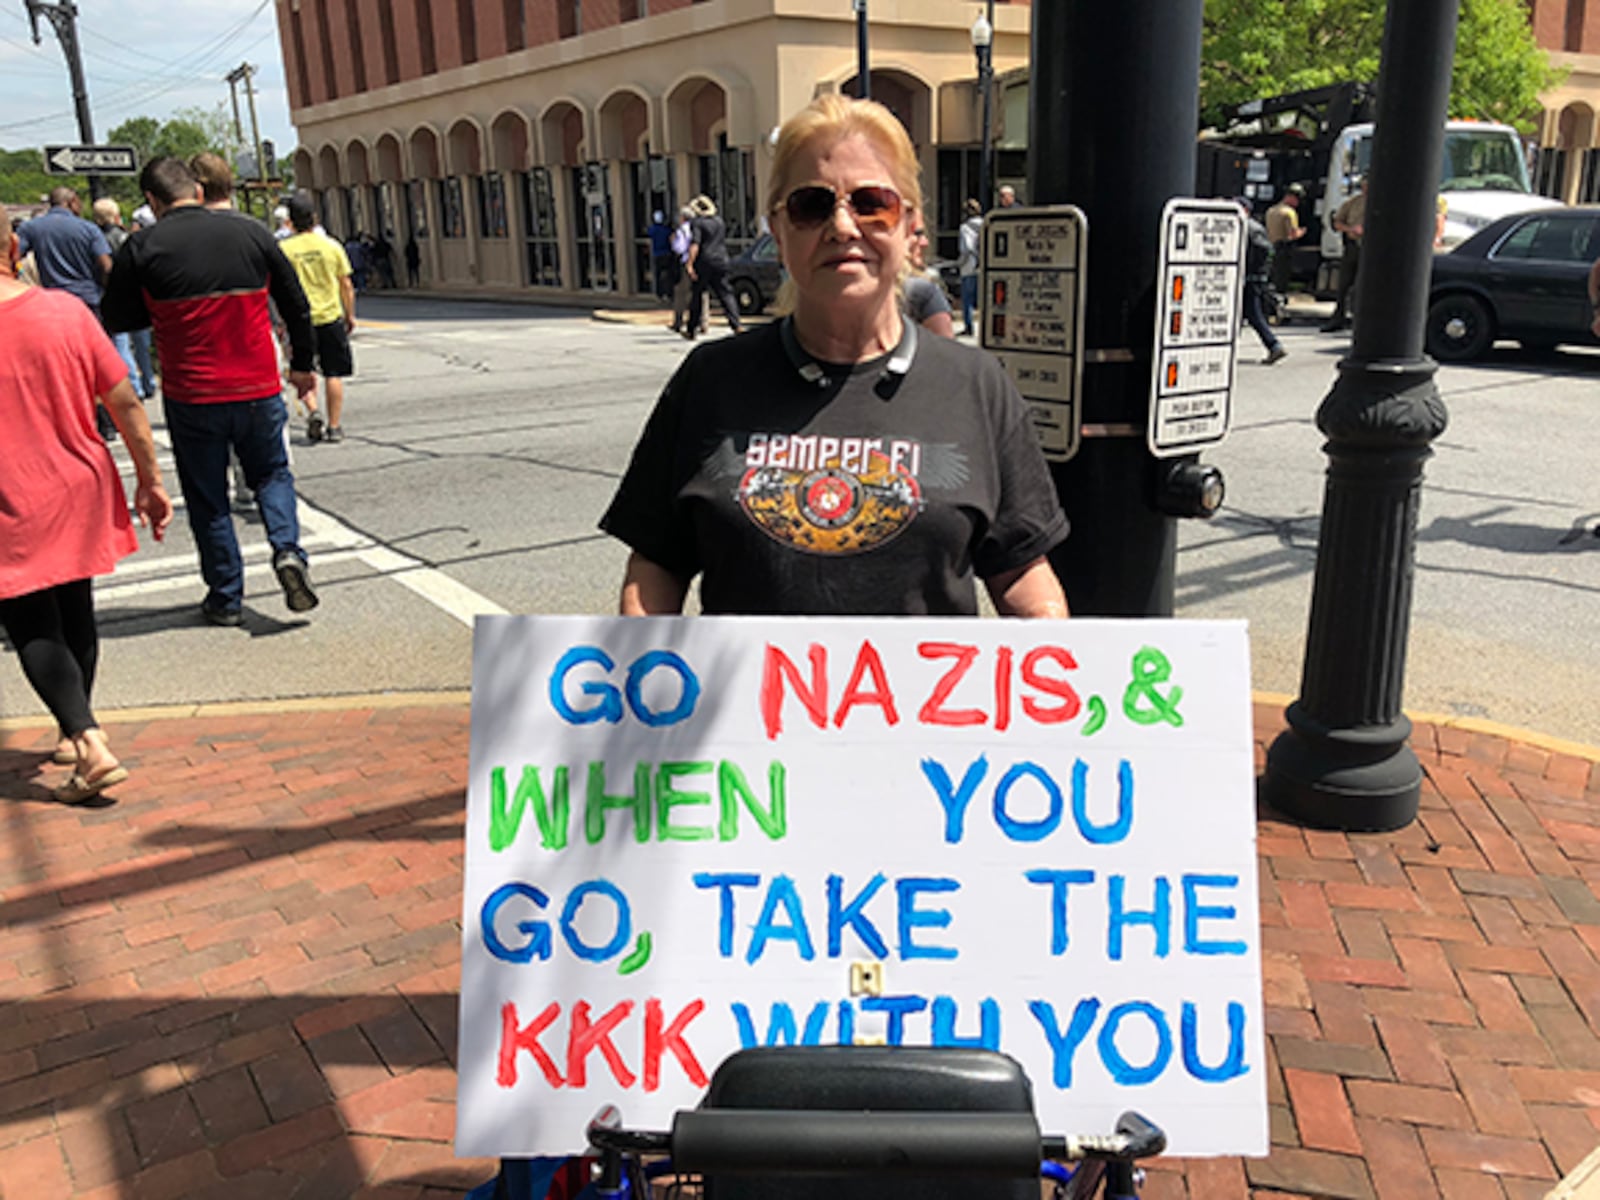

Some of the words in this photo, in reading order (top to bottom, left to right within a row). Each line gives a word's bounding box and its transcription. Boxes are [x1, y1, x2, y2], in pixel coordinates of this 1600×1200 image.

[548, 645, 701, 728] GO
[761, 640, 1107, 740] NAZIS,
[1123, 645, 1183, 727] &
[489, 760, 787, 852] WHEN
[920, 755, 1134, 845] YOU
[480, 878, 652, 975] GO,
[693, 872, 961, 965] TAKE
[1023, 868, 1249, 960] THE
[496, 998, 712, 1092] KKK
[1028, 997, 1251, 1090] YOU
